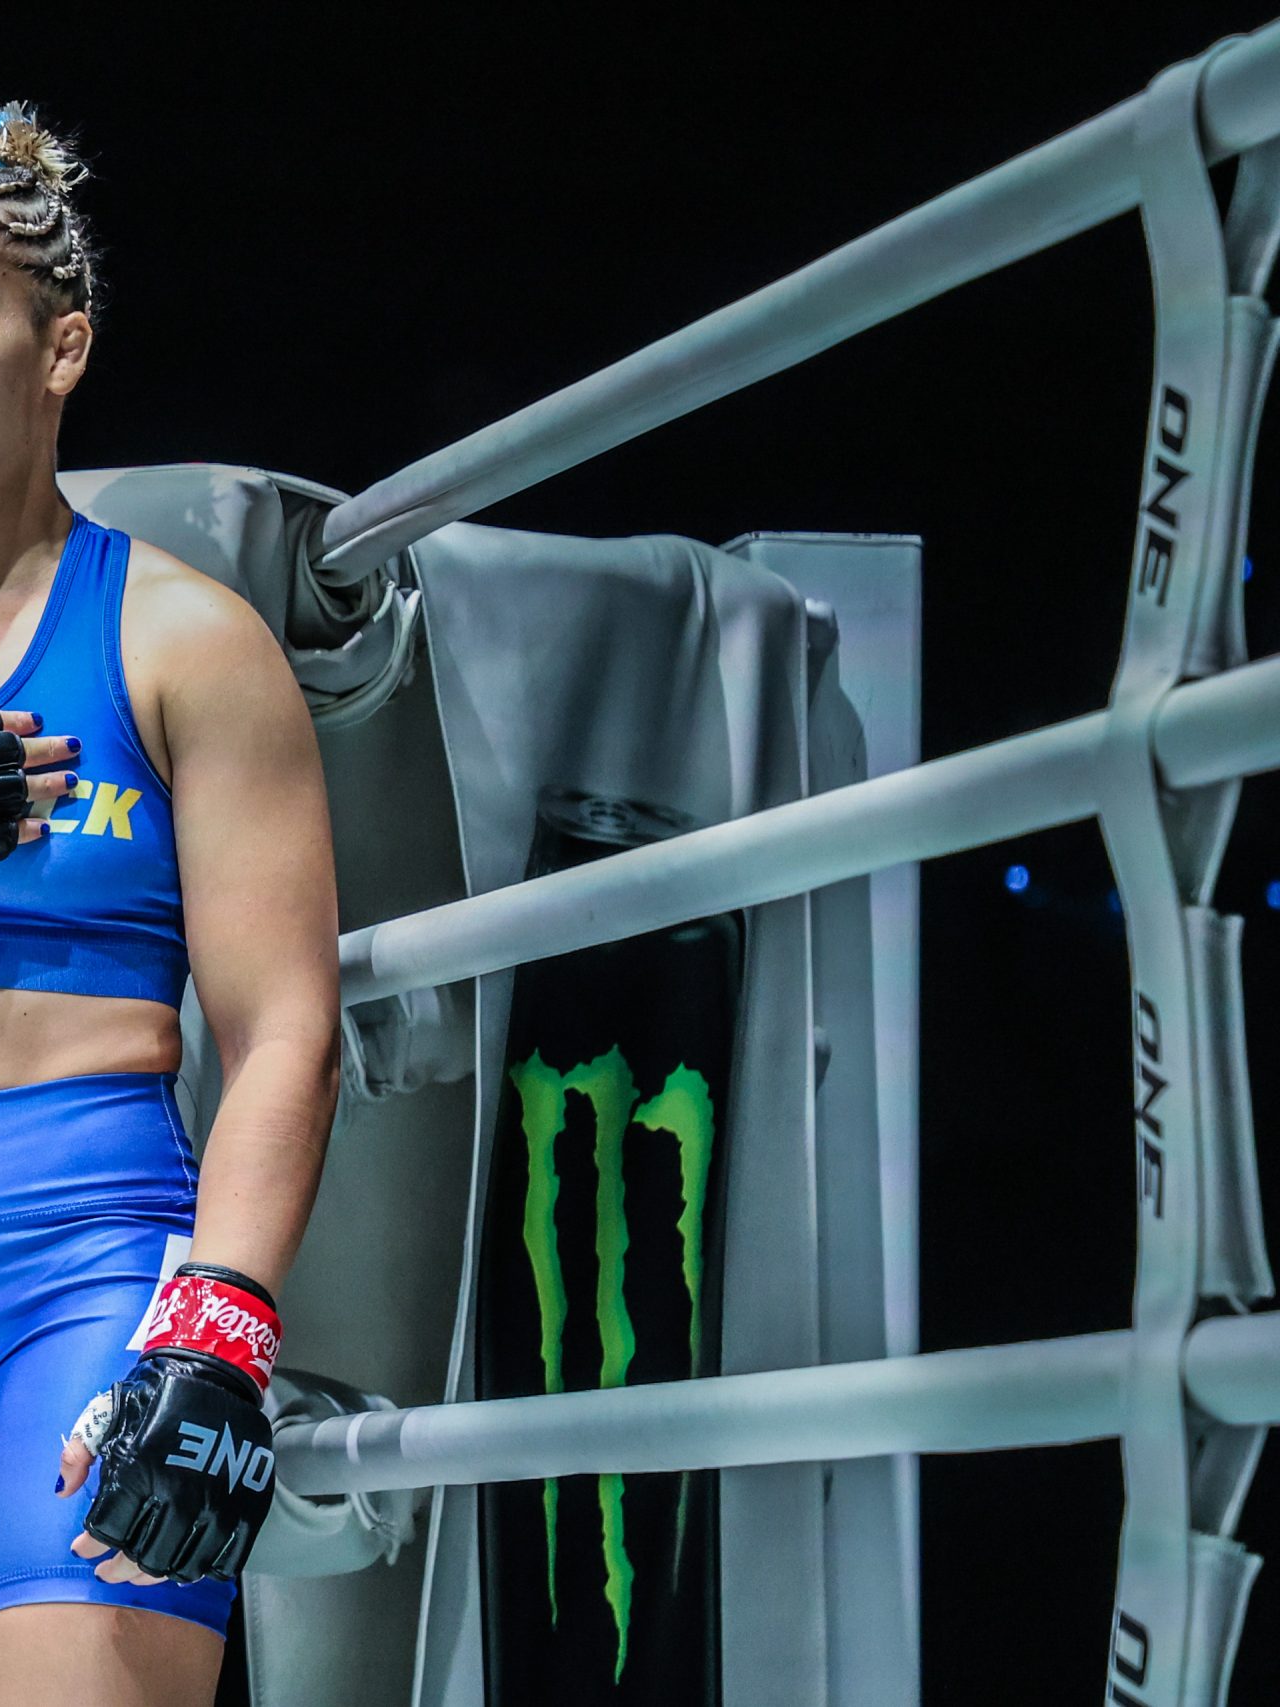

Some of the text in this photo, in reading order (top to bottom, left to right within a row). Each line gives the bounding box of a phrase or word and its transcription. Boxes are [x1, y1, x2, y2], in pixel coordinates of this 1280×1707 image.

[1137, 384, 1190, 607] ONE
[1134, 990, 1168, 1220] ONE
[165, 1420, 275, 1495] ONE
